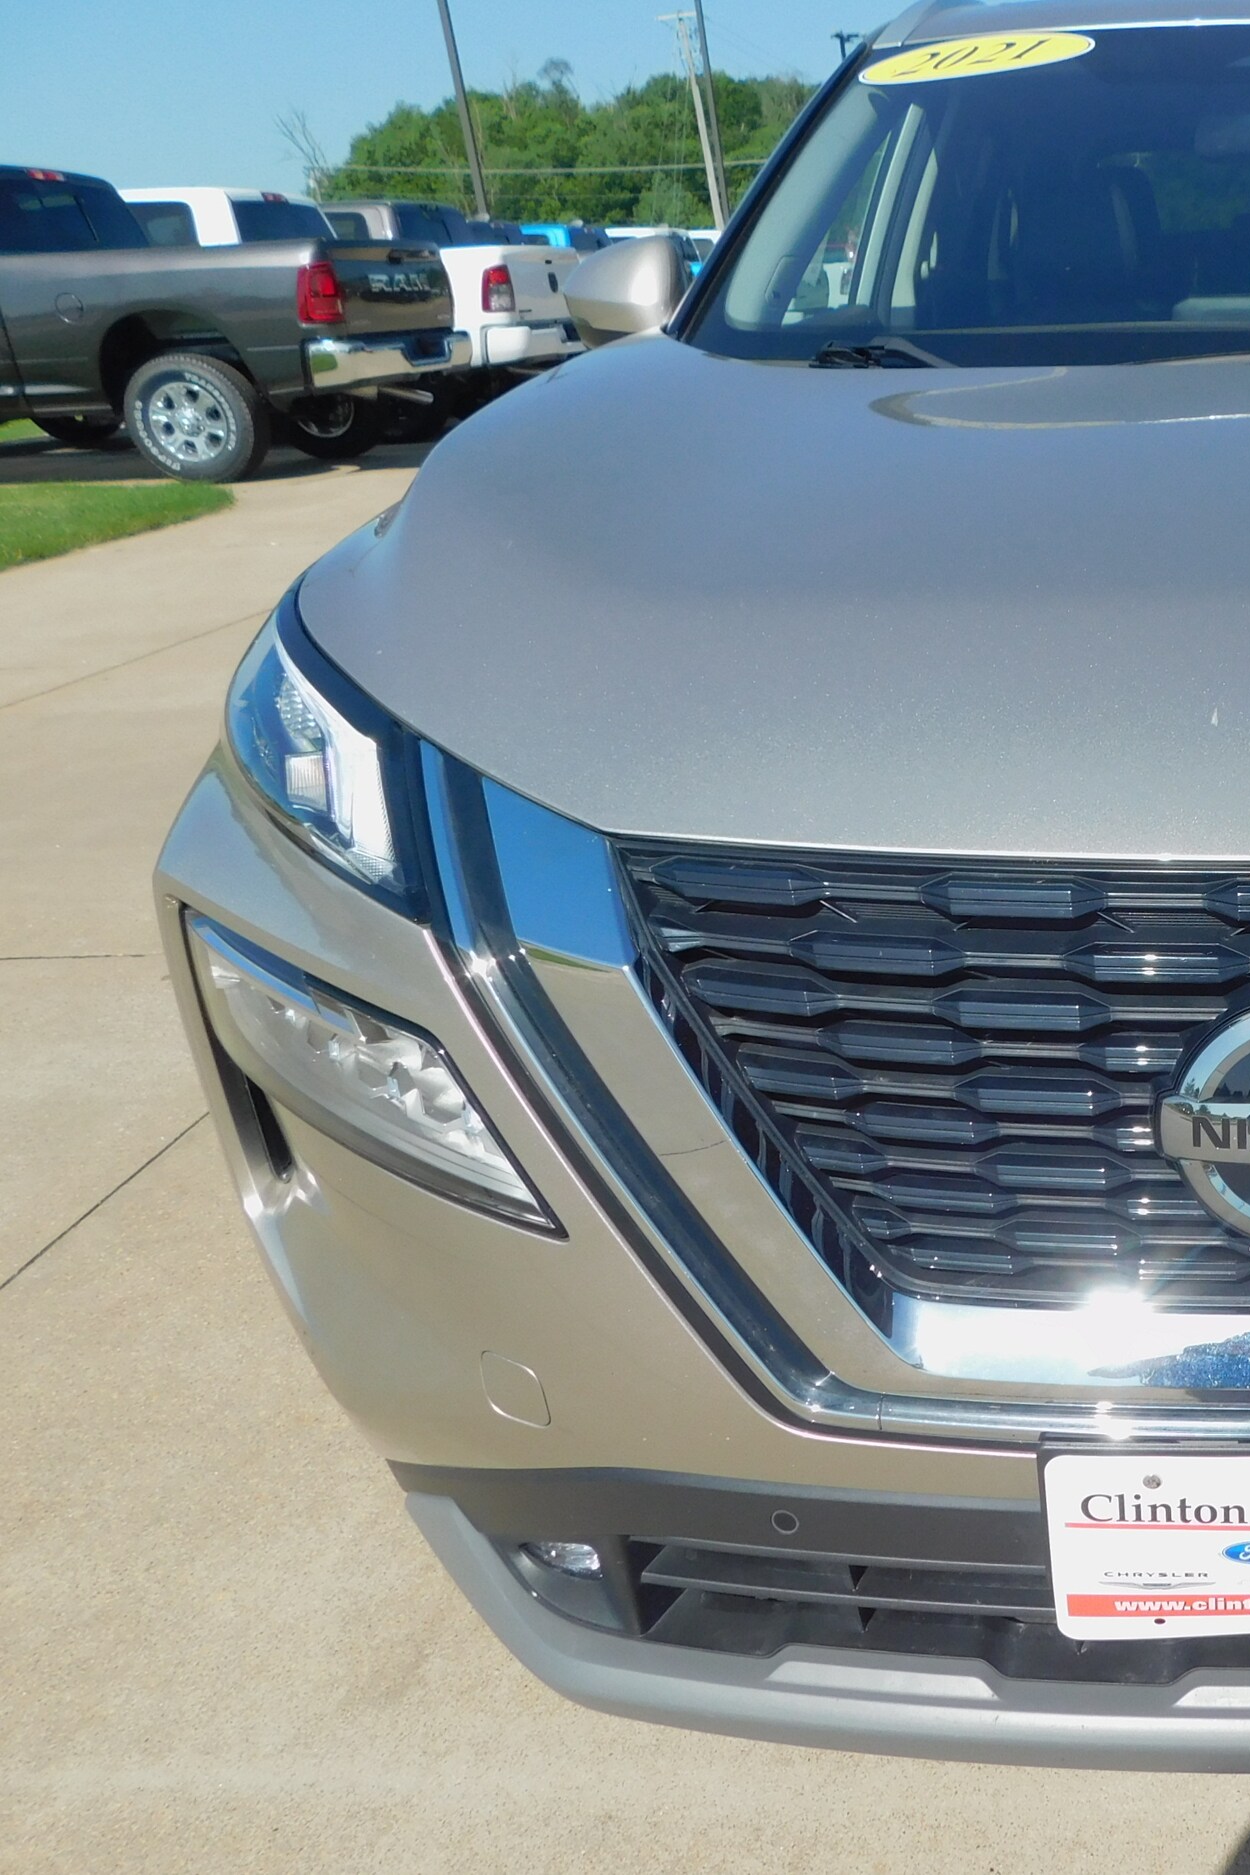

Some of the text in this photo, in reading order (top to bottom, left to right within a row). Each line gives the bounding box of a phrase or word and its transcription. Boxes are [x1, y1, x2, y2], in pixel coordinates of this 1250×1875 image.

[893, 38, 1051, 77] 2021
[367, 272, 431, 292] RAM
[1081, 1493, 1248, 1524] Clinton
